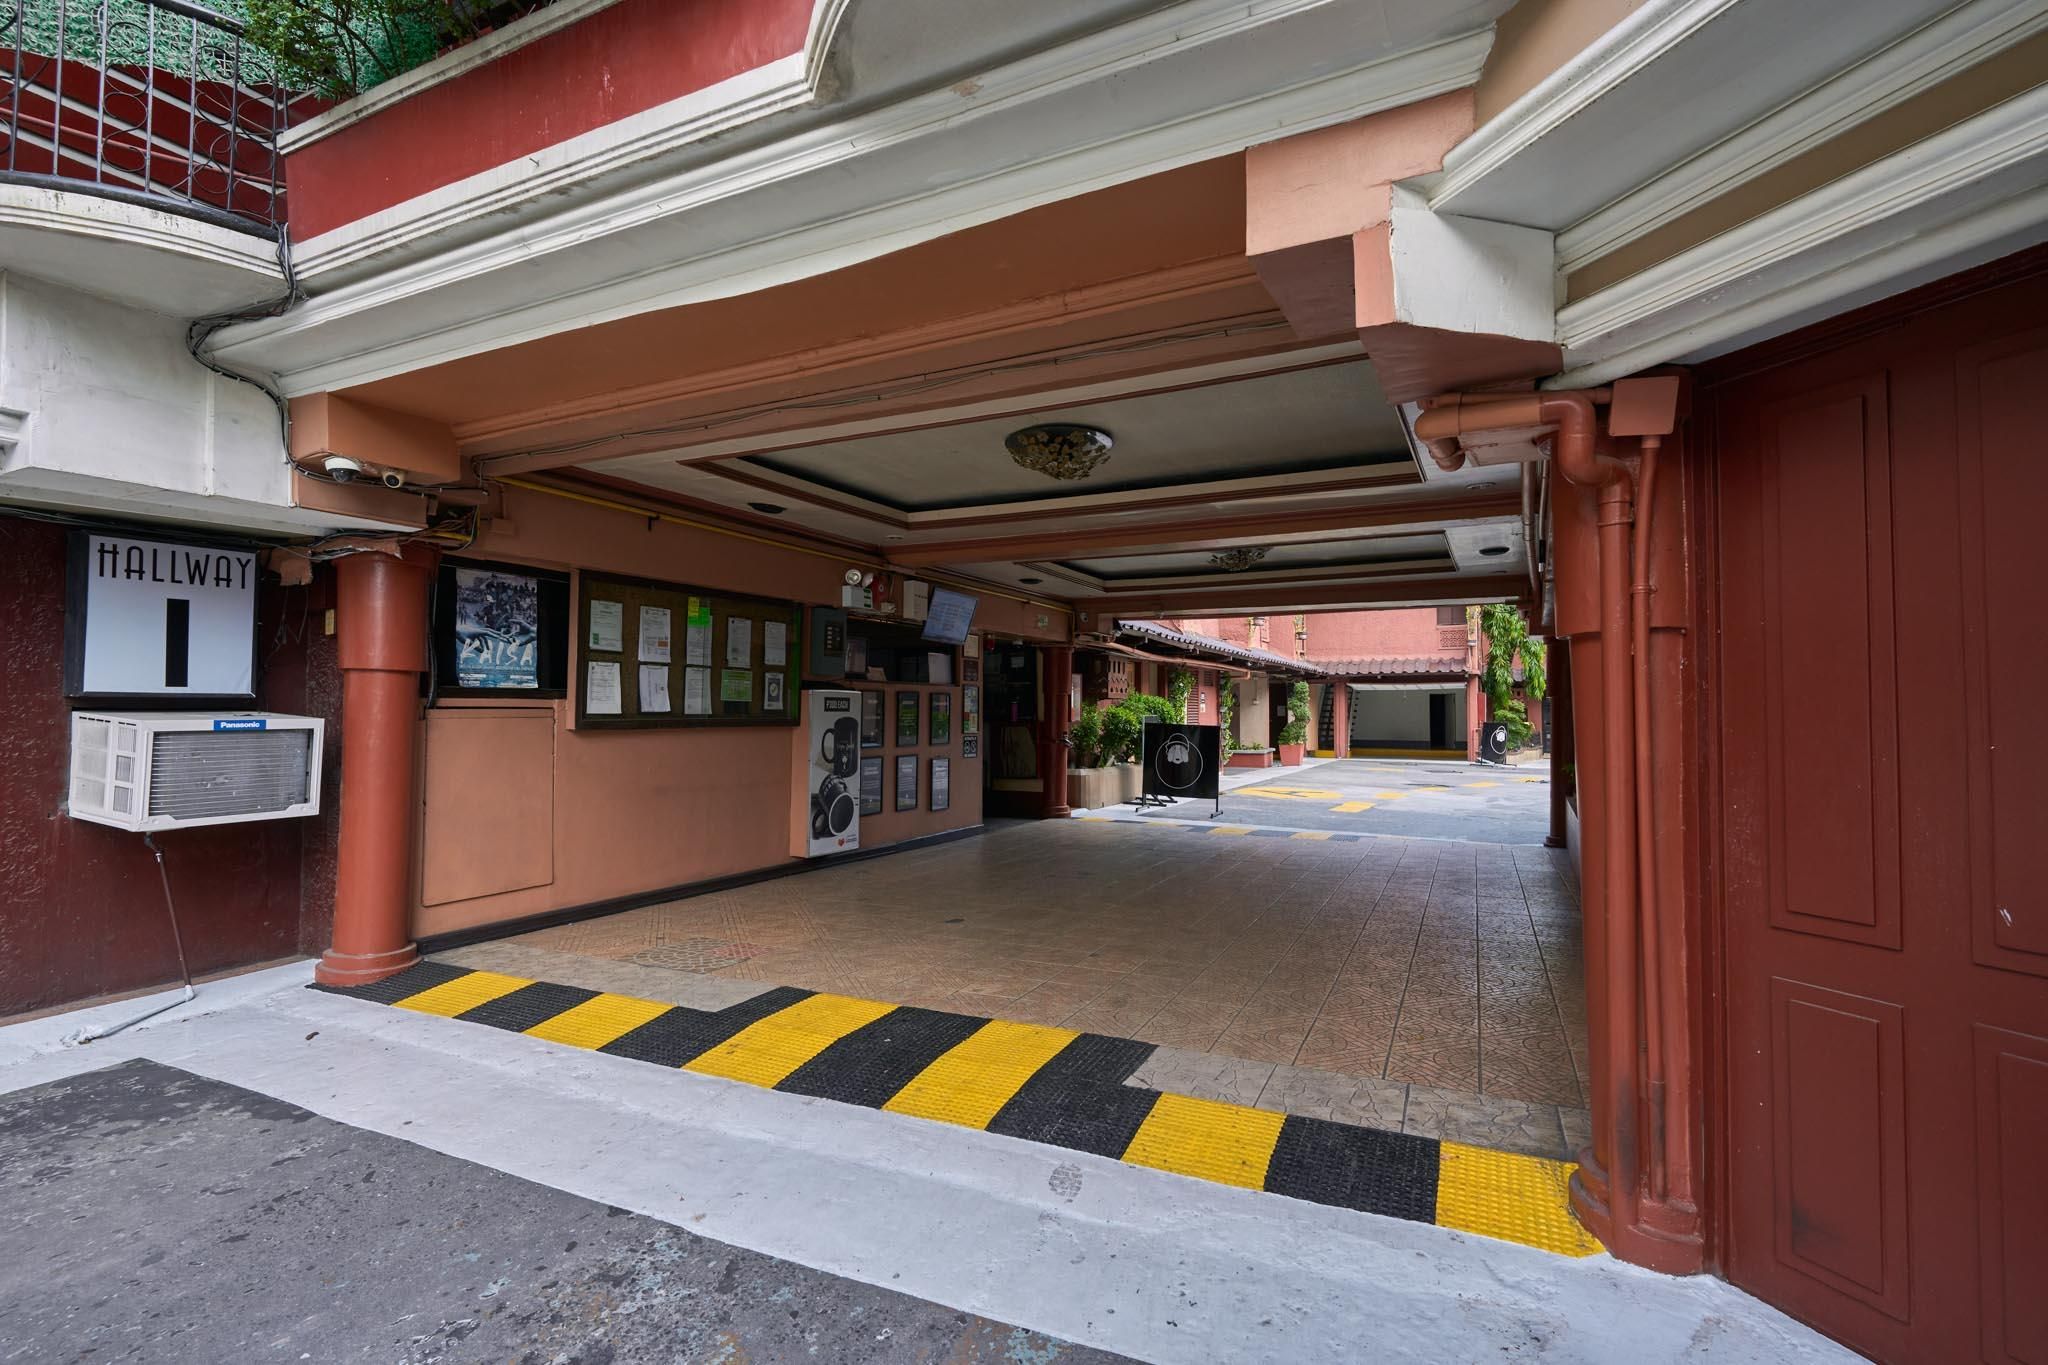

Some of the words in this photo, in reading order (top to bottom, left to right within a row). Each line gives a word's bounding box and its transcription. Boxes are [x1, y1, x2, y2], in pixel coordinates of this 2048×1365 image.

[98, 542, 252, 589] HALLWAY
[460, 637, 534, 666] KAISA
[220, 721, 260, 729] Panasonic
